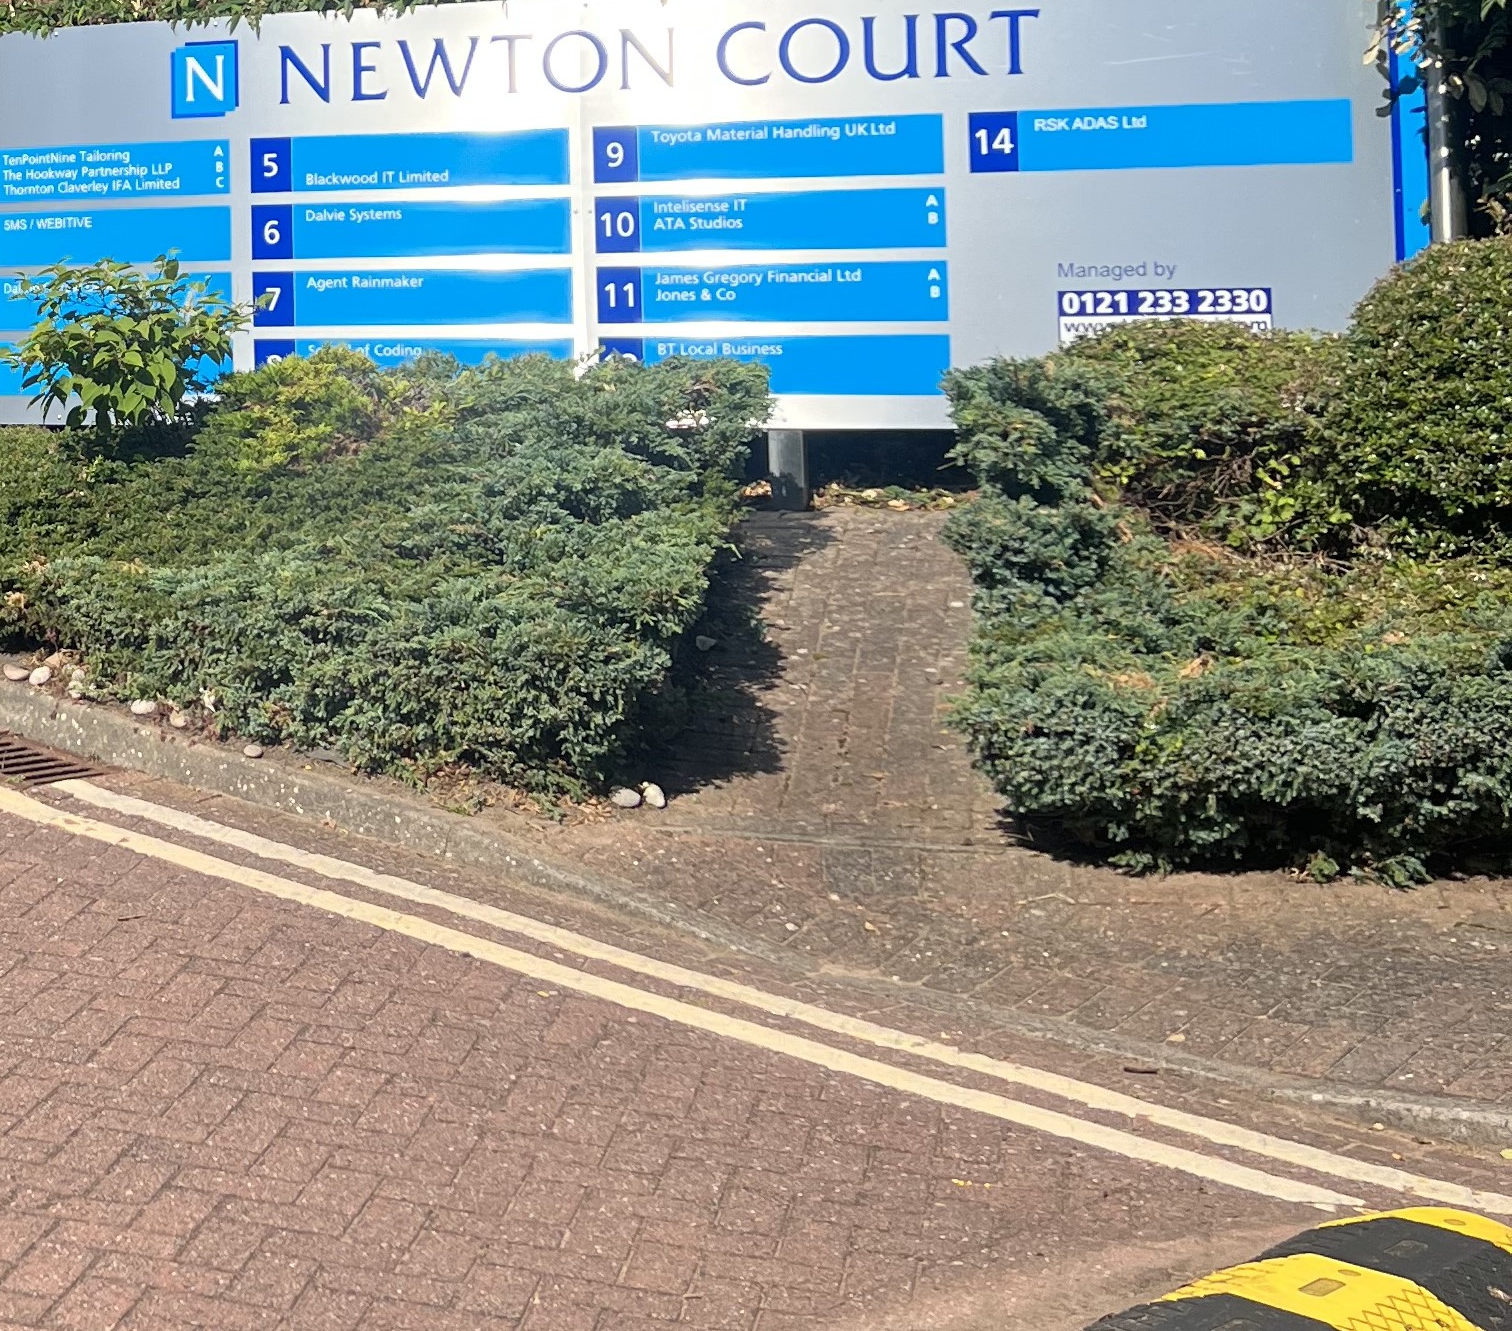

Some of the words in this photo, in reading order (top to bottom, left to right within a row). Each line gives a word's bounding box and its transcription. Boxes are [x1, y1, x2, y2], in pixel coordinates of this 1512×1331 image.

[278, 28, 675, 105] NEWTON
[716, 8, 1041, 86] COURT
[185, 54, 225, 102] N
[1034, 118, 1069, 132] RSK
[1071, 116, 1119, 130] ADAS
[1122, 116, 1147, 129] Ltd
[651, 130, 702, 145] Toyota
[706, 127, 768, 141] Material
[772, 124, 841, 141] Handling
[845, 123, 868, 137] UK
[870, 122, 896, 136] Ltd
[974, 127, 1015, 155] 14
[3, 152, 77, 166] TenPointNine
[79, 150, 130, 164] Tailoring
[213, 145, 224, 157] A
[605, 141, 625, 168] 9
[3, 169, 23, 181] The
[25, 168, 78, 180] Hookway
[81, 164, 148, 178] Partnership
[151, 162, 173, 175] LLP
[215, 161, 224, 173] B
[263, 152, 279, 178] 5
[3, 184, 55, 195] Thornton
[57, 181, 109, 194] Claverley
[112, 179, 132, 191] IFA
[135, 177, 180, 191] Limited
[215, 176, 224, 188] C
[305, 172, 378, 186] Blackwood
[382, 171, 395, 183] IT
[399, 170, 449, 184] Limited
[733, 198, 748, 211] IT
[925, 194, 938, 207] A
[36, 216, 92, 229] WEBITIVE
[305, 209, 346, 222] Dalvie
[349, 208, 402, 223] Systems
[653, 217, 685, 230] ATA
[689, 216, 743, 230] Studios
[927, 211, 939, 225] B
[263, 219, 281, 245] 6
[600, 211, 635, 238] 10
[655, 272, 699, 285] James
[702, 270, 763, 286] Gregory
[767, 269, 832, 283] Financial
[836, 269, 862, 282] Ltd
[927, 268, 940, 281] A
[1056, 262, 1148, 280] Managed
[1152, 260, 1178, 280] by
[306, 276, 348, 292] Agent
[351, 275, 424, 288] Rainmaker
[929, 285, 941, 298] B
[265, 287, 281, 312] 7
[604, 282, 635, 308] 11
[656, 289, 696, 302] Jones
[700, 288, 712, 301] &
[715, 287, 736, 301] Co
[1061, 291, 1129, 315] 0121
[1137, 290, 1191, 314] 233
[1197, 289, 1268, 313] 2330
[374, 344, 424, 358] Coding
[657, 343, 677, 356] BT
[680, 342, 718, 355] Local
[721, 342, 783, 356] Business
